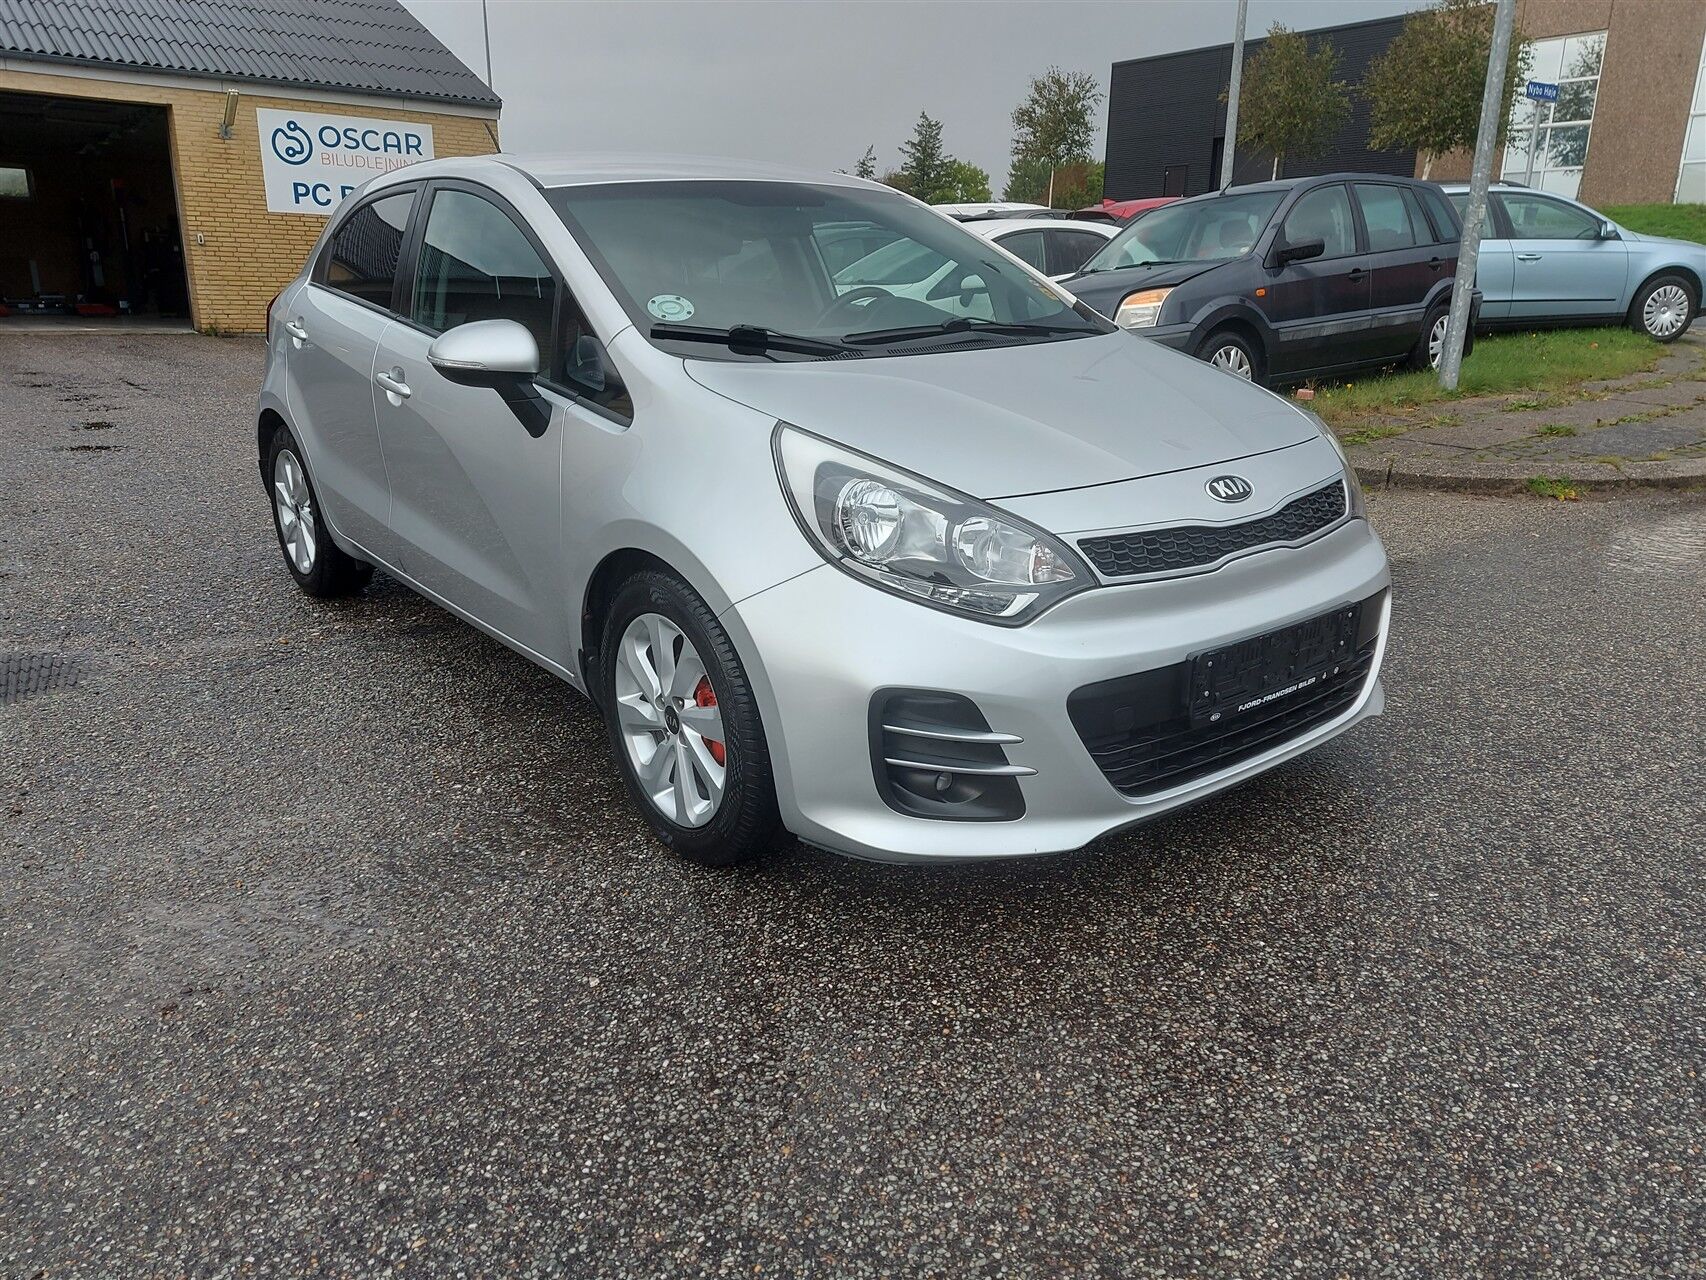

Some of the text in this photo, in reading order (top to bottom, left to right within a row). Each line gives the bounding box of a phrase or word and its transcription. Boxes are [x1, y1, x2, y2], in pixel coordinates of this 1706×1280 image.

[318, 125, 423, 156] OSCAR
[320, 152, 421, 173] BILUDLEJNIN
[292, 182, 332, 206] PC
[1211, 477, 1250, 497] KIA
